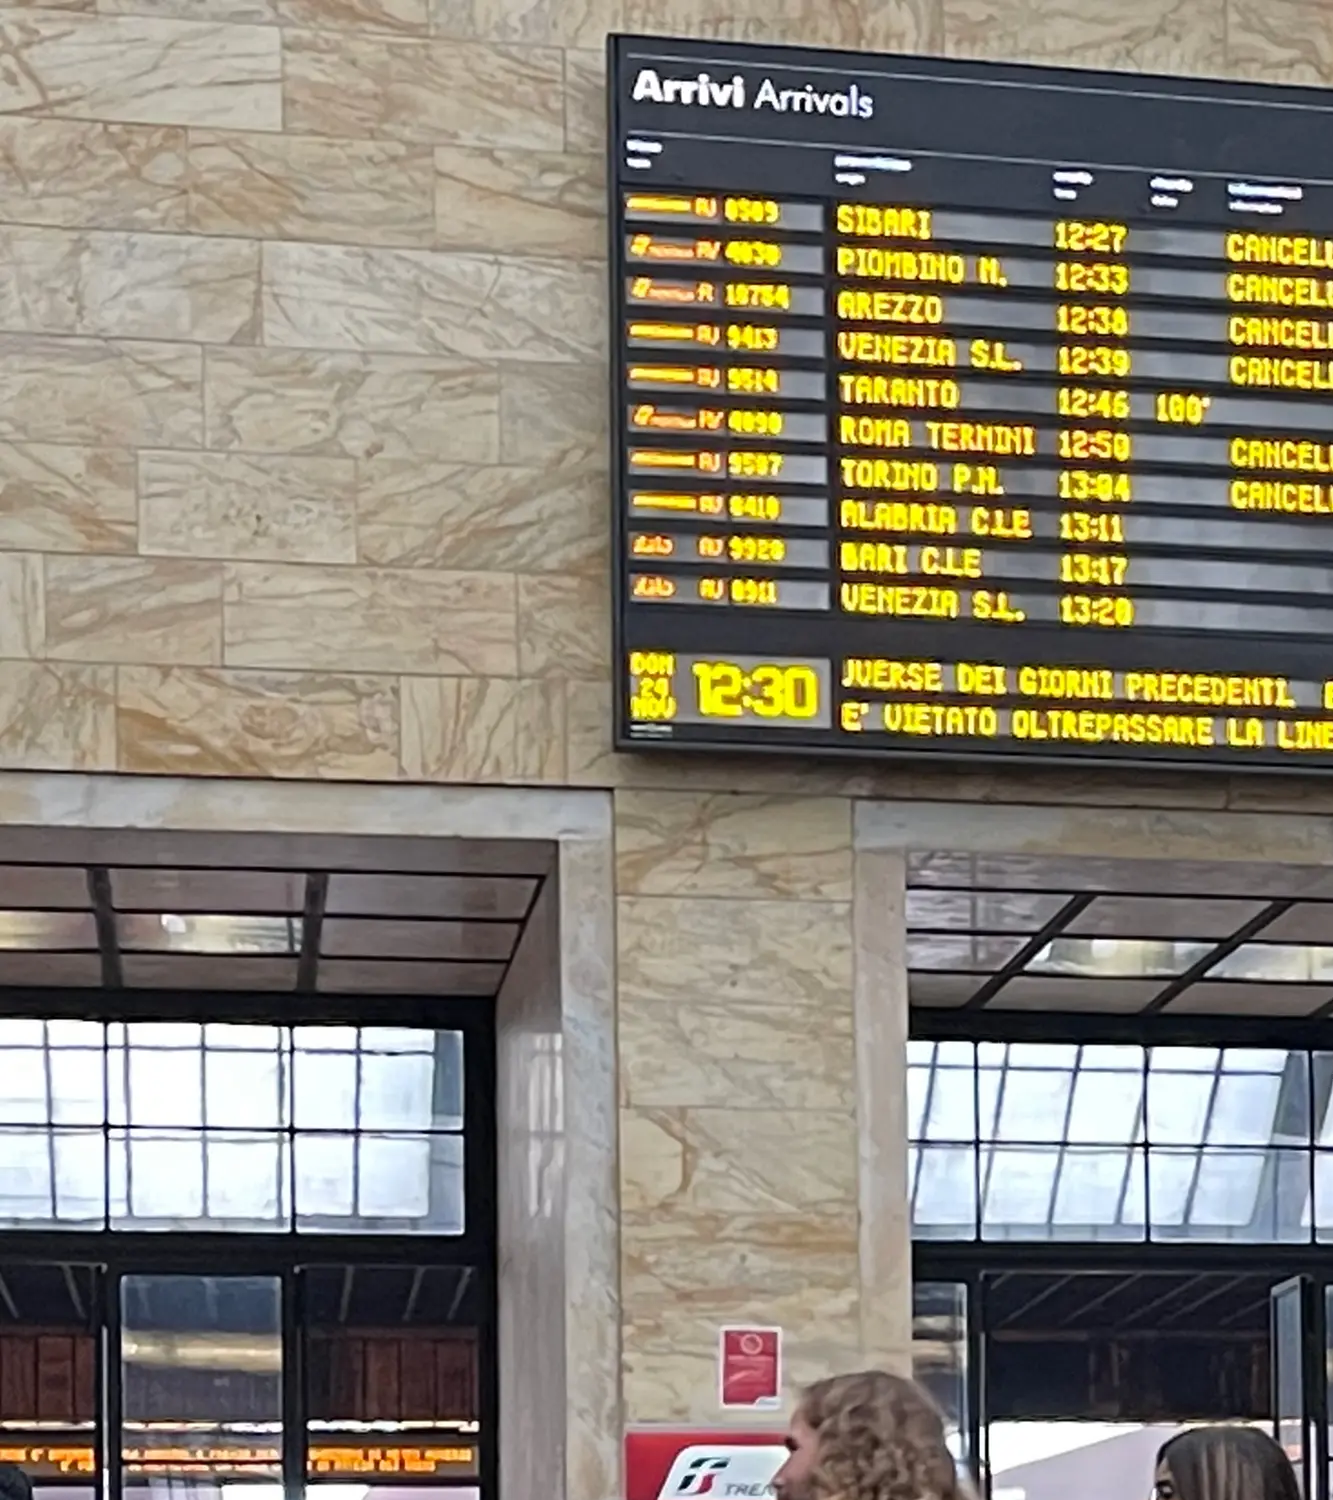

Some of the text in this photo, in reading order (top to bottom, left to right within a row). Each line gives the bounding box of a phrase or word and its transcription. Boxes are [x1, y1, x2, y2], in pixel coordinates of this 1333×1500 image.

[633, 68, 874, 118] Arrivi Arrivals
[838, 205, 932, 239] SIBARI
[1057, 222, 1126, 252] 12:27
[838, 247, 968, 283] PIOMBINO
[1057, 263, 1130, 294] 12:33
[839, 291, 944, 323] AREZZO
[1057, 306, 1130, 336] 12:38
[839, 332, 958, 366] VENEZIA
[971, 340, 1021, 370] S.L.
[1060, 347, 1132, 376] 12:39
[840, 375, 960, 408] TARANTO
[1060, 388, 1130, 418] 12:46
[841, 416, 913, 447] ROMA
[927, 422, 1035, 454] TERMINI
[1060, 430, 1133, 461] 12:50
[842, 459, 941, 491] TORINO
[1060, 471, 1132, 501] 13:04
[842, 500, 960, 534] ALABRIA
[969, 507, 1032, 538] C.LE
[1061, 512, 1124, 542] 13:11
[842, 543, 909, 574] BARI
[919, 547, 981, 578] C.LE
[1061, 554, 1127, 585] 13:17
[842, 583, 960, 616] VENEZIA
[973, 591, 1025, 621] S.L.
[1062, 595, 1135, 625] 13:20
[692, 662, 818, 718] 12:30
[957, 663, 1008, 694] DEI
[1017, 667, 1115, 699] GIORNI
[843, 702, 868, 731] E'
[882, 703, 999, 736] VIETATO
[1012, 710, 1215, 745] OLTREPASSARE
[1226, 718, 1266, 746] LA
